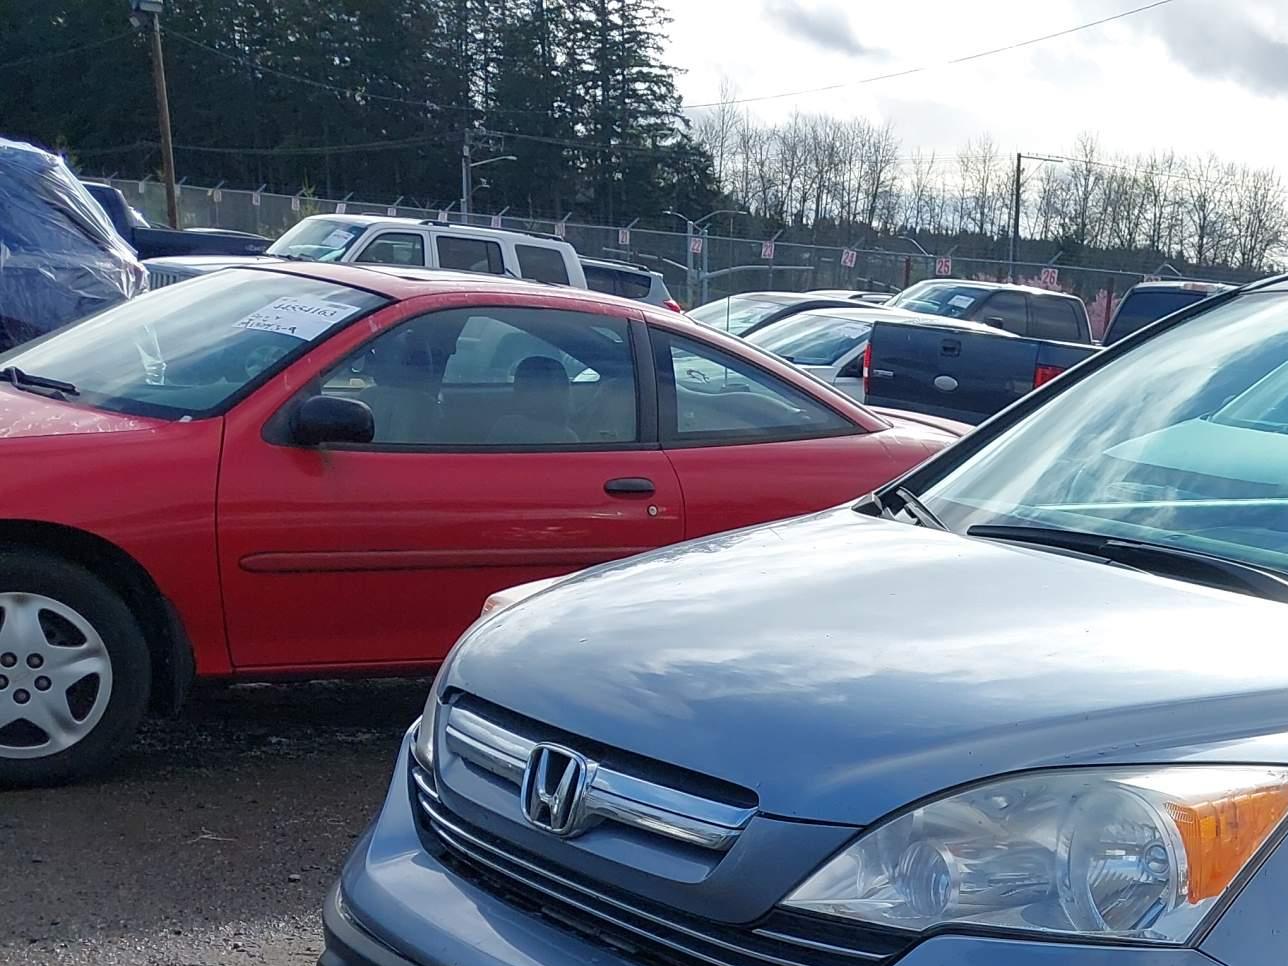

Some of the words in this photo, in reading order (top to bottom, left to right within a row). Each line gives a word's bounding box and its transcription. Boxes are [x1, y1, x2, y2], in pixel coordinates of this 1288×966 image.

[691, 239, 701, 251] 22
[763, 243, 774, 257] 23
[843, 251, 855, 265] 24
[937, 259, 950, 274] 25
[1042, 270, 1056, 285] 26
